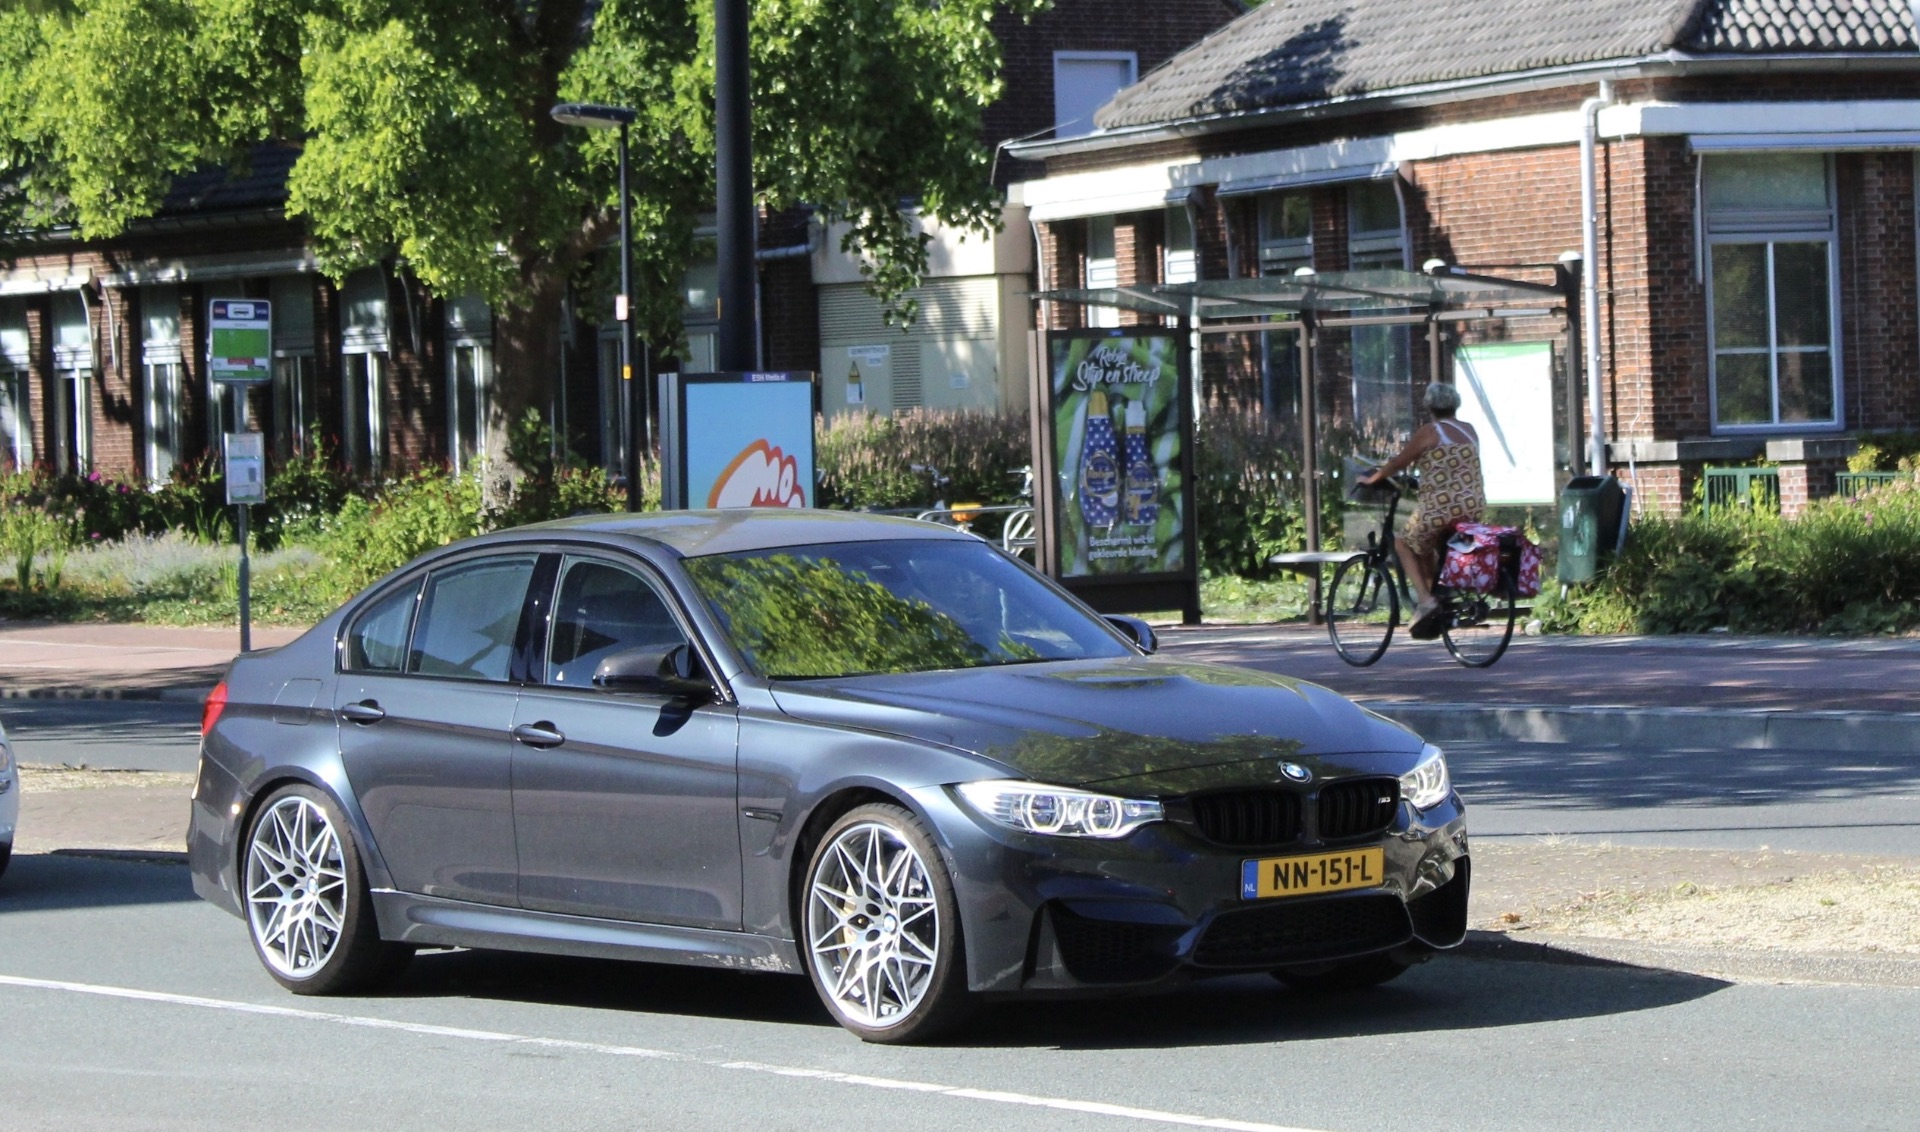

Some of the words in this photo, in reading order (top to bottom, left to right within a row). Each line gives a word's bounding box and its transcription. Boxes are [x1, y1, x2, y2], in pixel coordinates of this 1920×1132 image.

[1105, 369, 1121, 383] en
[1273, 855, 1373, 891] NN-151-L
[1244, 883, 1256, 892] NL
